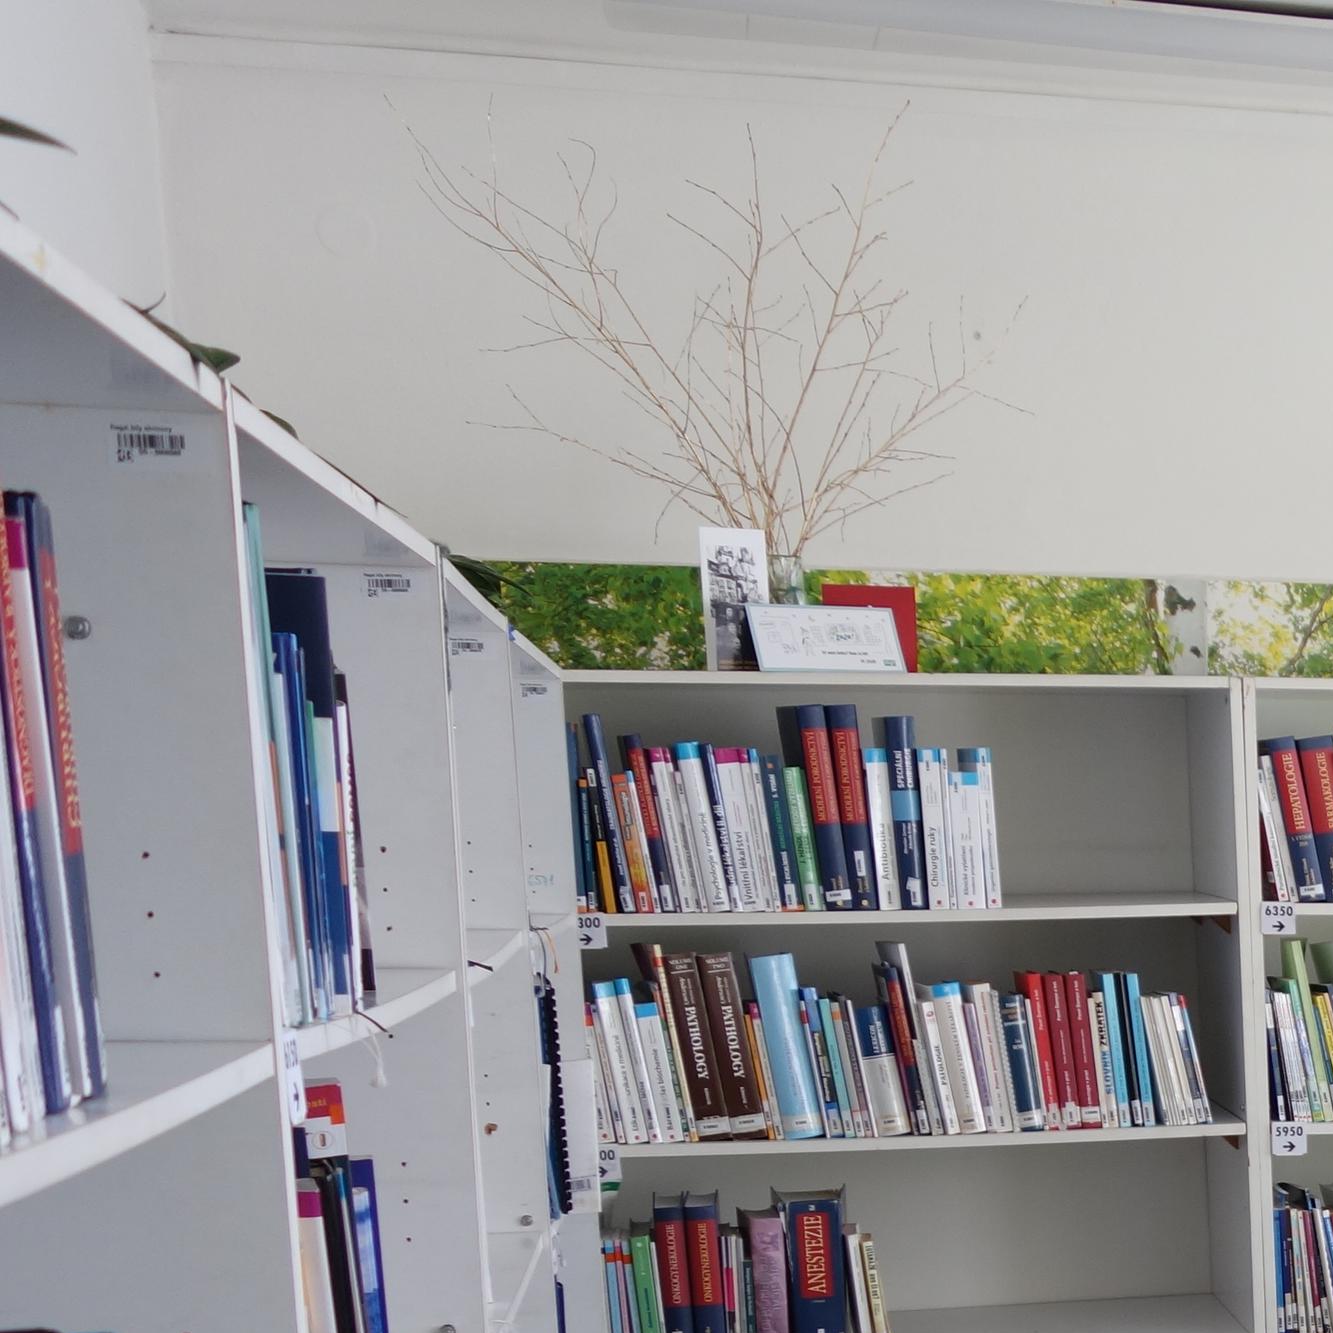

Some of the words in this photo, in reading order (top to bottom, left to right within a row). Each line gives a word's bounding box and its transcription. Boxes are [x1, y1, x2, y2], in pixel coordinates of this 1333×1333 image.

[1282, 753, 1306, 830] HEPATOLOGIE
[734, 831, 747, 869] lékařství
[928, 827, 938, 846] ruky
[708, 855, 723, 900] Psychologie
[724, 866, 736, 886] udní
[739, 871, 753, 900] Vnitřní
[930, 848, 939, 887] Chirurgie
[577, 916, 601, 929] 300
[1265, 905, 1293, 917] 6350
[684, 1007, 709, 1080] PATHOLOGY
[720, 1005, 745, 1079] PATHOLOGY
[1095, 1001, 1108, 1047] ZKRATEK
[934, 1045, 947, 1085] PATOLOGIE
[1275, 1126, 1304, 1137] 5950
[599, 1149, 615, 1161] 00
[666, 1224, 682, 1304] ONKOGYNEKOLOGIE
[698, 1223, 713, 1302] ONKOGYNEKOLOGIE
[803, 1215, 827, 1294] ANESTEZIE
